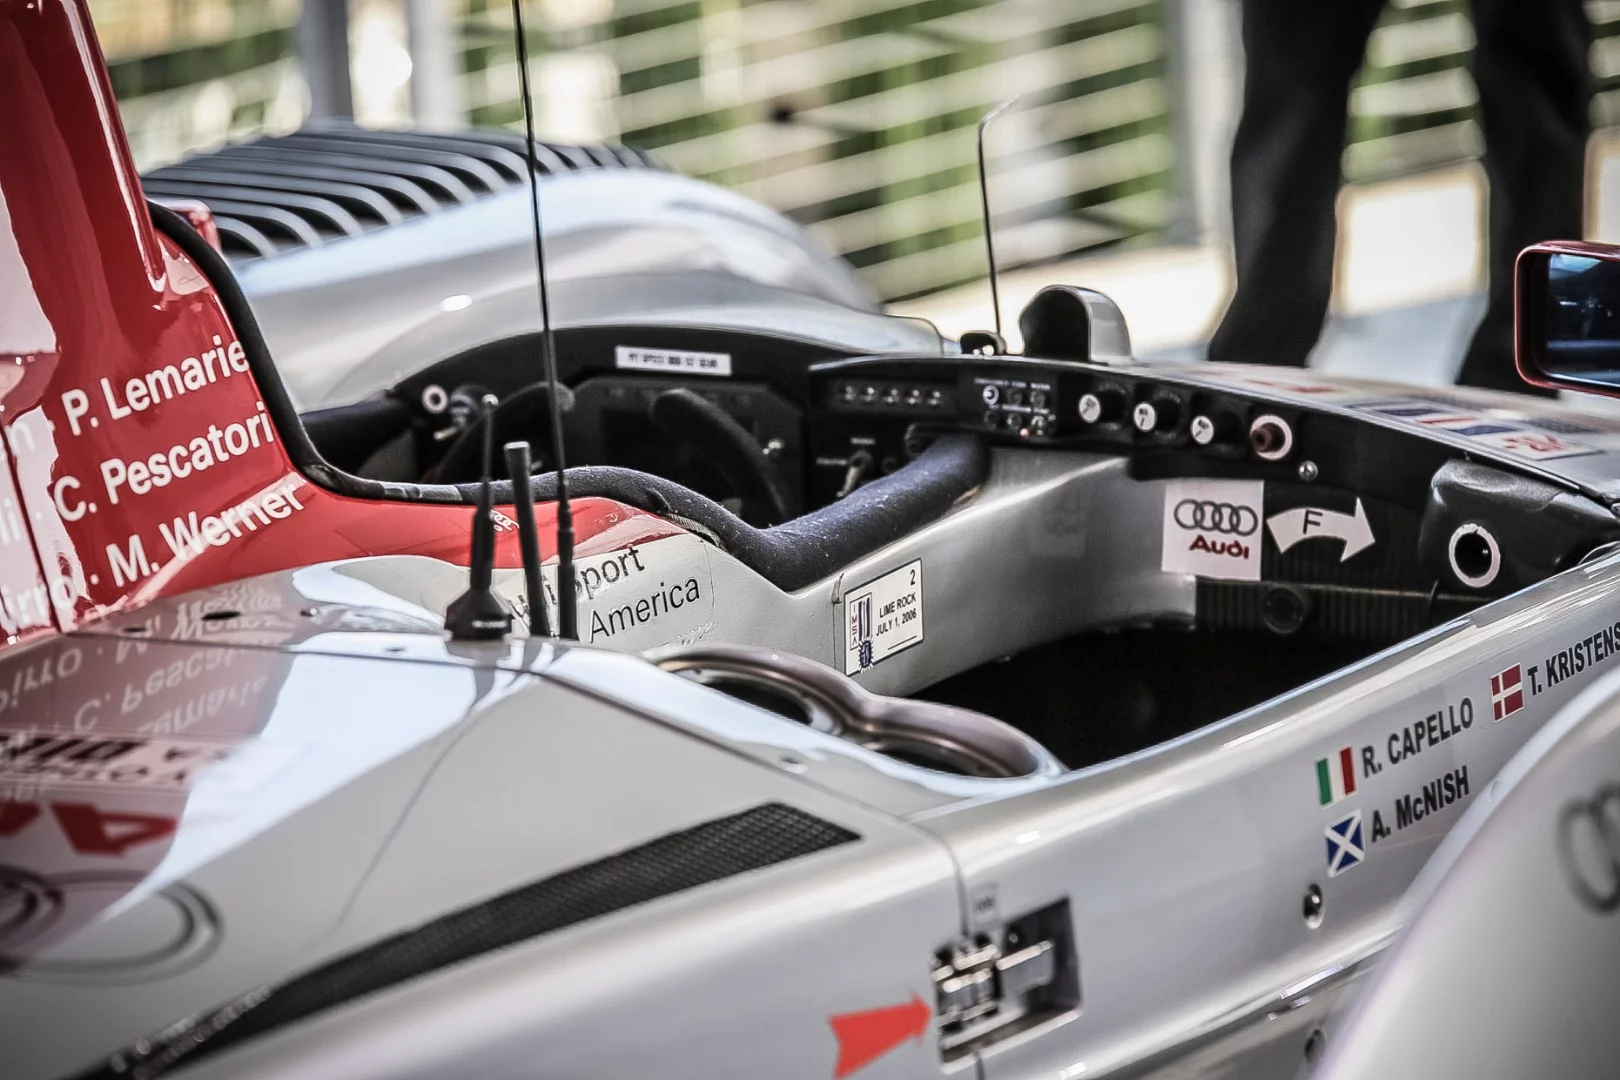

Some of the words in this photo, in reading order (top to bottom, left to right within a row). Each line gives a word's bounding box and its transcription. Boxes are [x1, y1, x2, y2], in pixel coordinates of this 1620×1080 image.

[61, 388, 99, 437] P.
[100, 334, 250, 421] Lemarie
[55, 475, 97, 521] C.
[100, 400, 274, 504] Pescatori
[105, 533, 160, 588] M.
[158, 483, 304, 562] Werner
[1188, 534, 1250, 560] Audi
[1303, 509, 1323, 535] F
[588, 576, 701, 643] America
[879, 601, 896, 619] LIME
[896, 592, 917, 611] ROCK
[910, 569, 916, 586] 2
[876, 619, 893, 636] JULY
[901, 608, 917, 625] 2006
[1527, 665, 1543, 696] T.
[1545, 621, 1620, 688] KRISTENS
[1361, 745, 1383, 779] R.
[1388, 697, 1474, 765] CAPELLO
[1371, 789, 1392, 843] A.
[1396, 764, 1470, 830] McNISH
